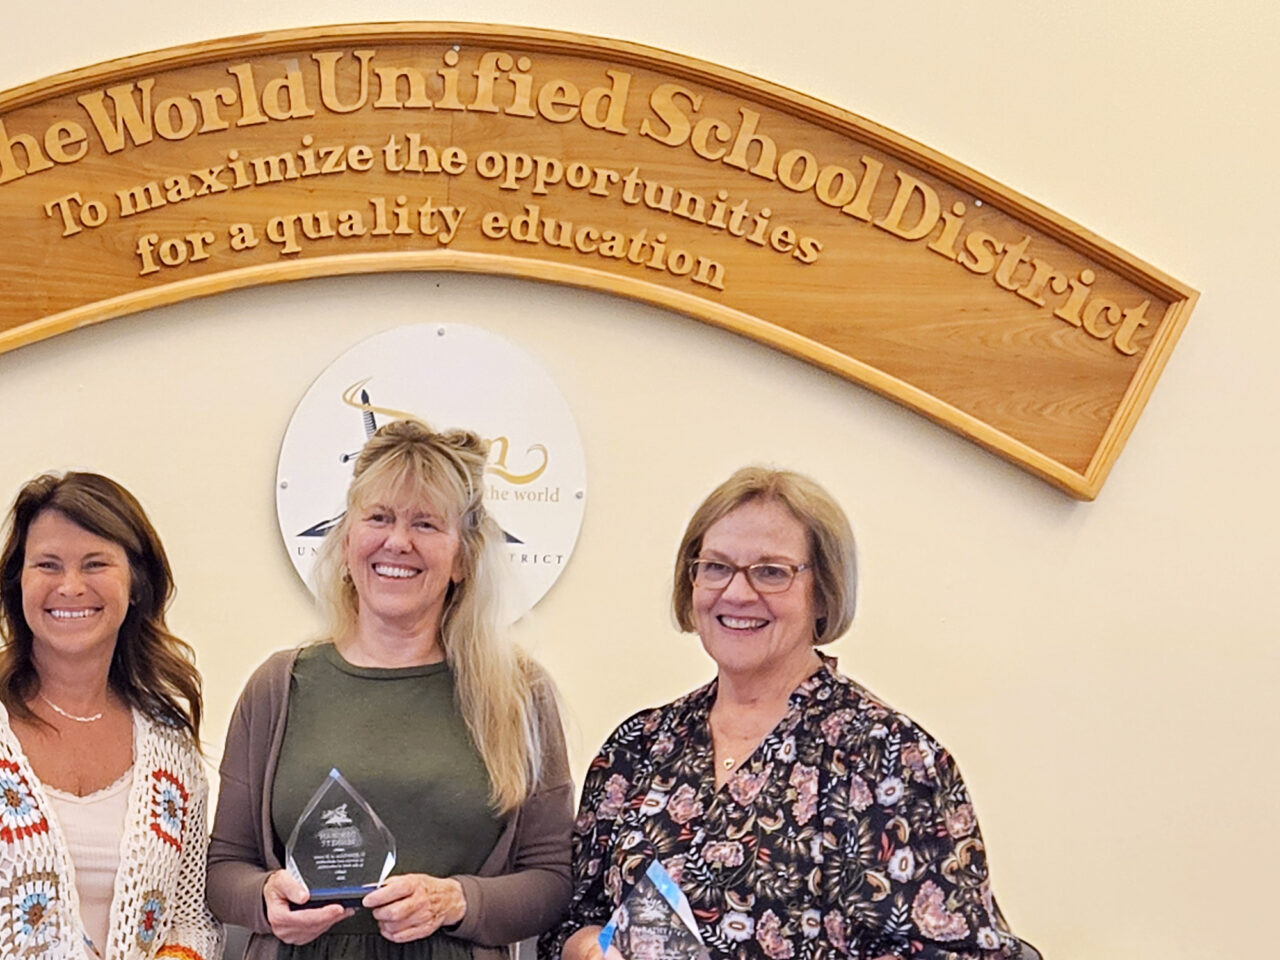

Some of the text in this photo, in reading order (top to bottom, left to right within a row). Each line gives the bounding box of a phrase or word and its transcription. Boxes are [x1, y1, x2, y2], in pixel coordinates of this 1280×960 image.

[44, 132, 824, 264] To maximize the opportunities
[77, 59, 316, 154] World
[311, 49, 631, 135] Unified
[639, 82, 884, 223] School
[872, 169, 1151, 356] District
[136, 194, 727, 291] for a quality education
[511, 487, 560, 503] world
